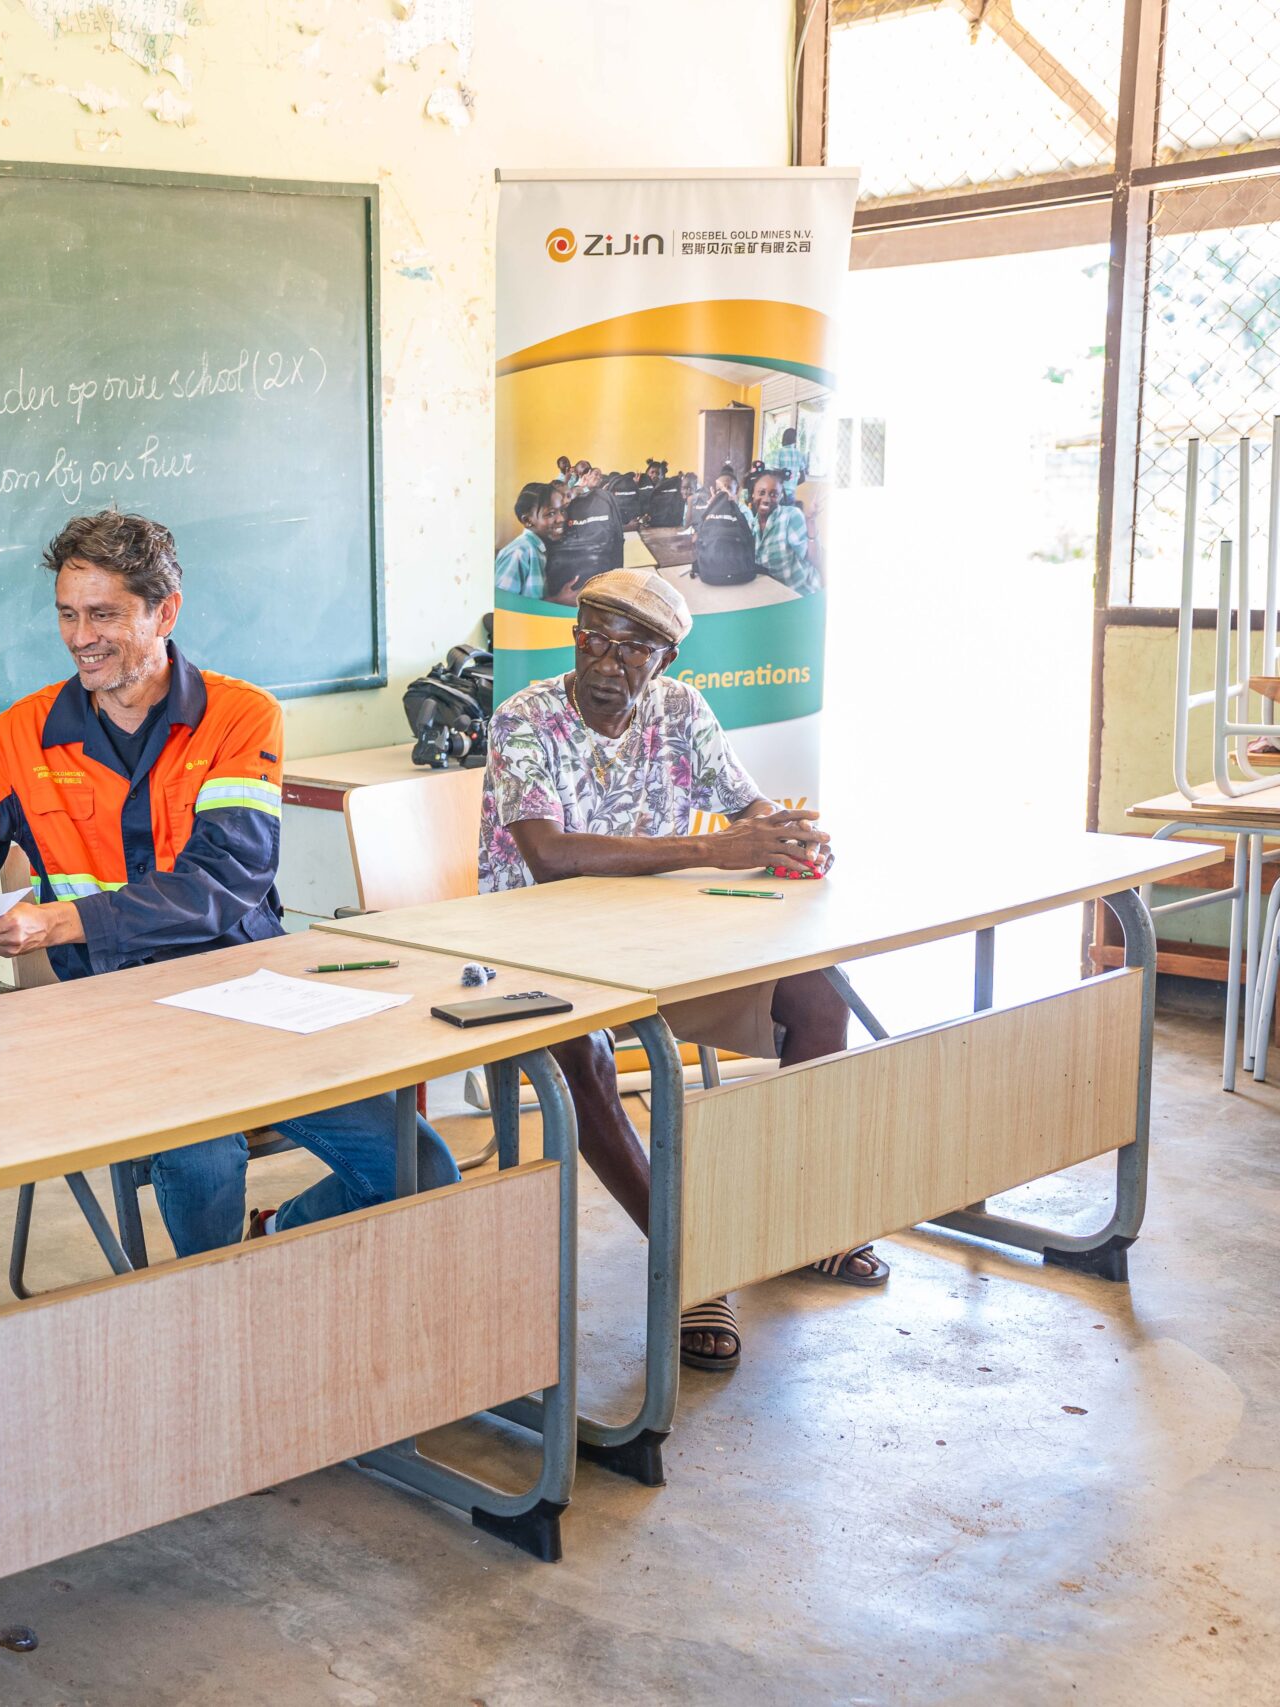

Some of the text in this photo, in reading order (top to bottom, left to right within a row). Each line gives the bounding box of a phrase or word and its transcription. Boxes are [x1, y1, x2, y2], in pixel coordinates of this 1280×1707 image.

[681, 230, 814, 240] ROSEBEL GOLD MINES N.V.
[681, 241, 811, 255] 罗斯贝尔金矿有限公司
[169, 348, 249, 400] school
[90, 458, 135, 485] ons
[138, 434, 196, 480] hier
[677, 663, 811, 691] Generations
